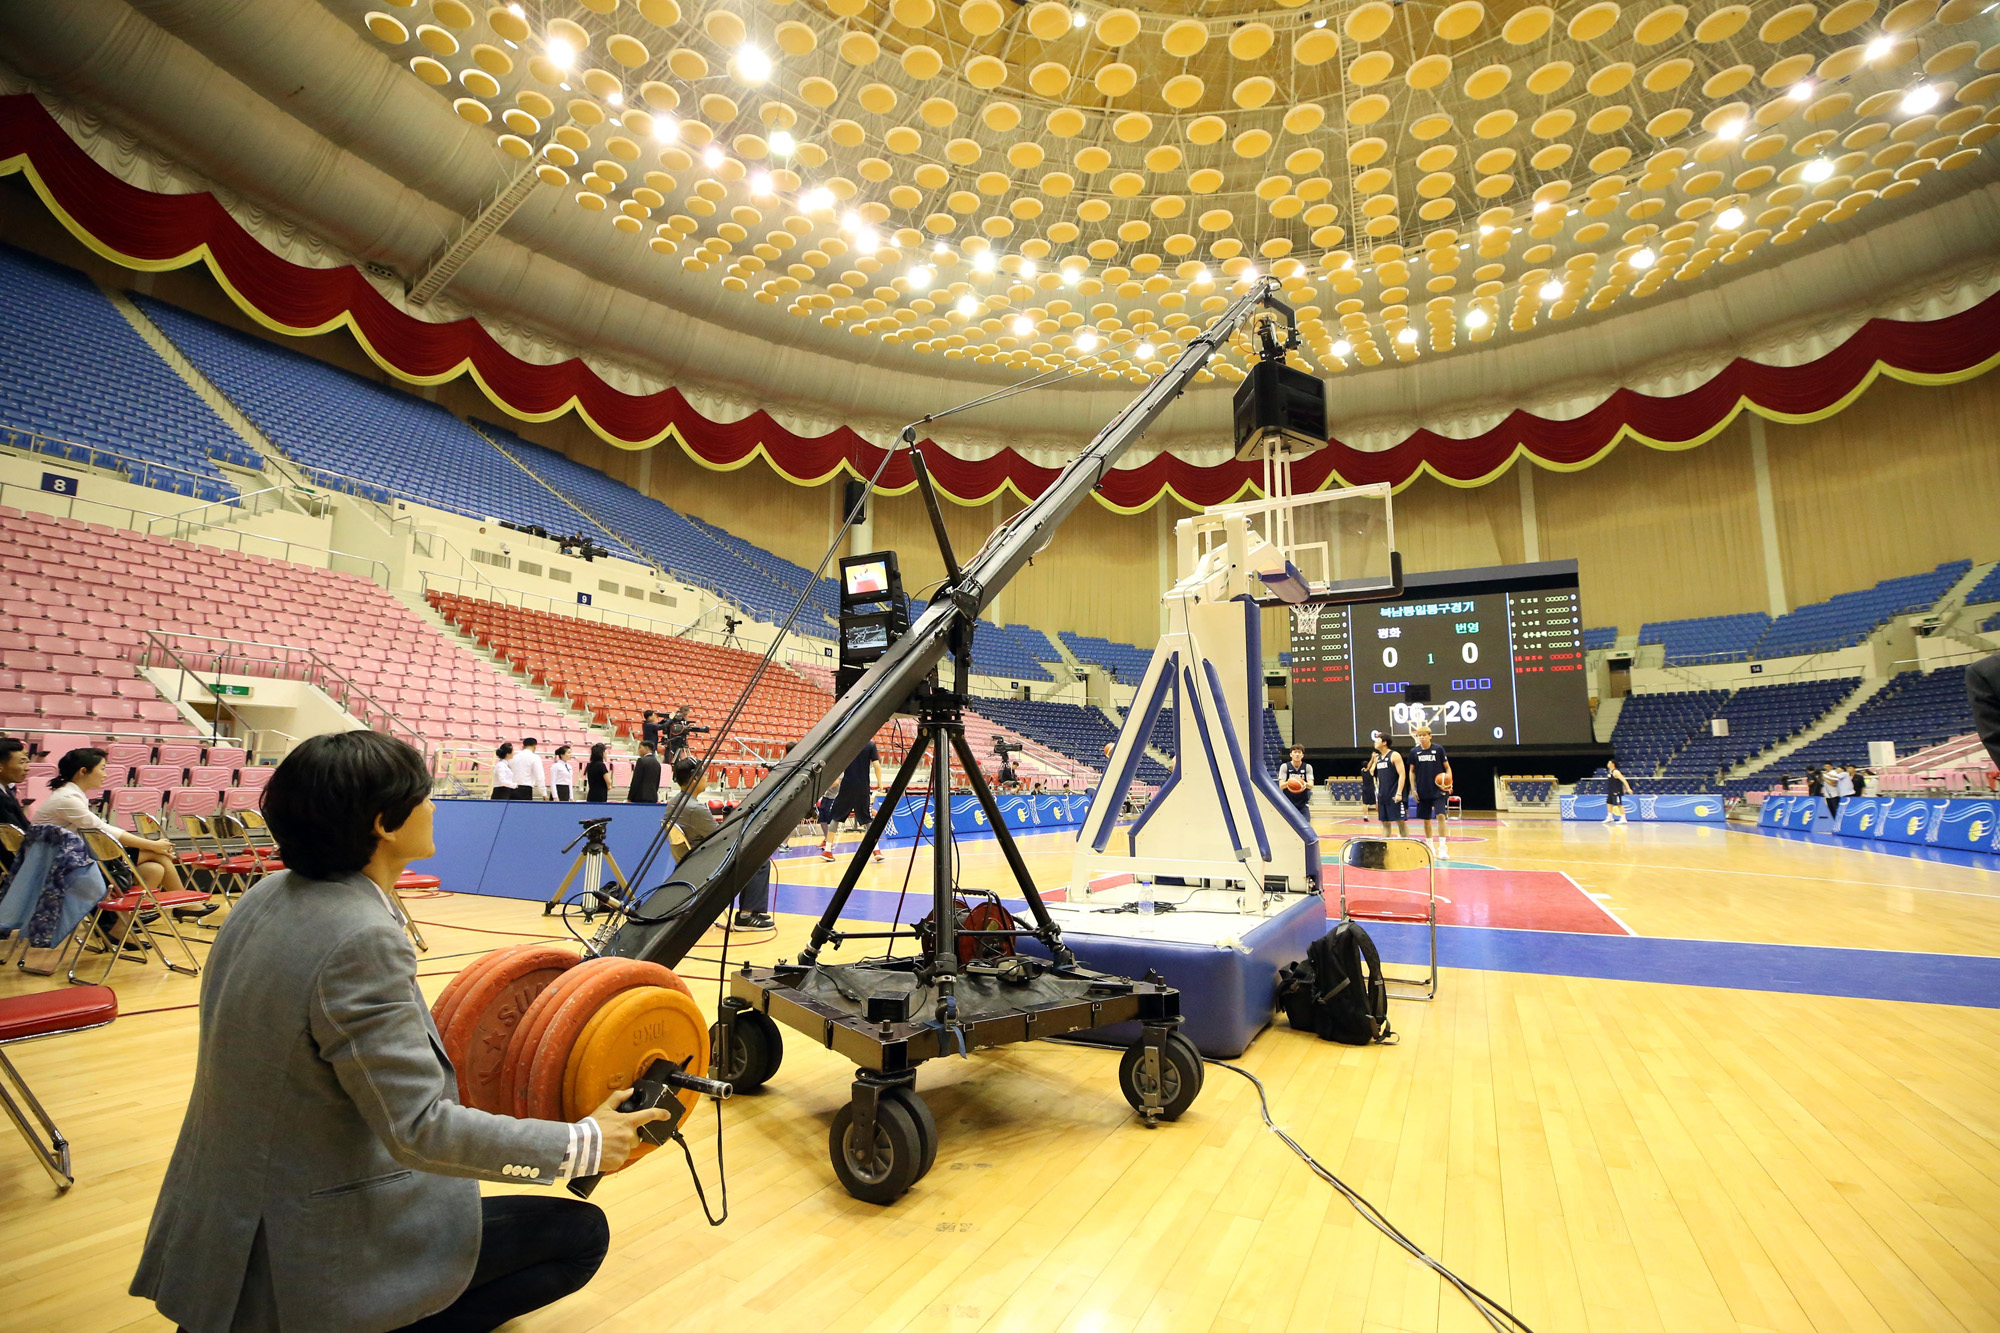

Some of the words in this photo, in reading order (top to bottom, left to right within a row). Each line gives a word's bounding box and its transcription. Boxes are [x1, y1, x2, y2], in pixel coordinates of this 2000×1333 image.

[54, 478, 66, 492] 8
[582, 595, 588, 604] 9
[1378, 627, 1401, 639] 평화
[1455, 622, 1480, 634] 번영
[1382, 647, 1398, 668] 0
[1428, 653, 1434, 664] 1
[1462, 642, 1478, 664] 0
[1494, 727, 1504, 739] 0
